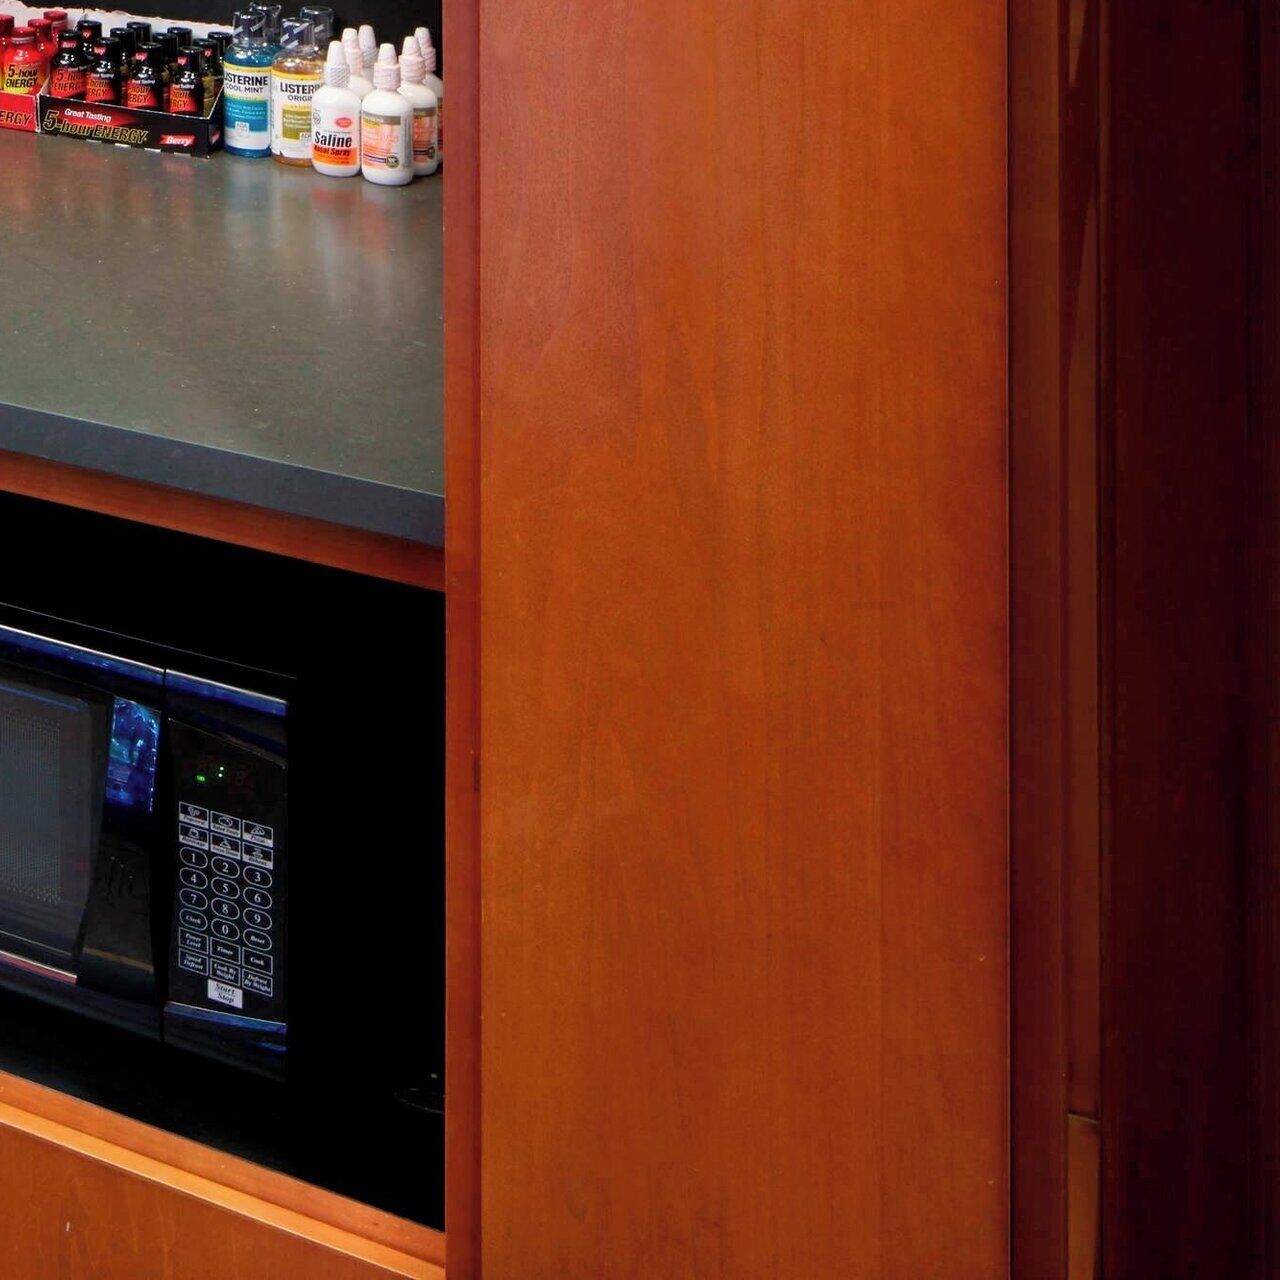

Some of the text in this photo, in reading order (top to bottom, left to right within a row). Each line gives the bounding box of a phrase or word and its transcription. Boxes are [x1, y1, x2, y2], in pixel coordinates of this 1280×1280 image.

[8, 63, 38, 77] 5-hour
[6, 76, 38, 88] ENERGY
[226, 83, 264, 94] COOL MINT
[65, 108, 112, 124] Great Tasting
[43, 110, 149, 145] 5-hour ENERGY
[166, 134, 192, 147] Berry
[314, 131, 353, 148] Saline
[330, 148, 351, 158] Spray
[222, 862, 229, 873] 2
[190, 874, 197, 884] 4
[254, 872, 261, 882] 3
[222, 883, 229, 893] 5
[190, 894, 197, 904] 7
[254, 893, 261, 903] 6
[222, 904, 229, 915] 8
[254, 914, 261, 924] 9
[222, 924, 229, 935] 0
[217, 946, 234, 955] Timer
[250, 957, 265, 966] Cook
[216, 983, 235, 994] Start
[218, 993, 235, 1004] Stop
